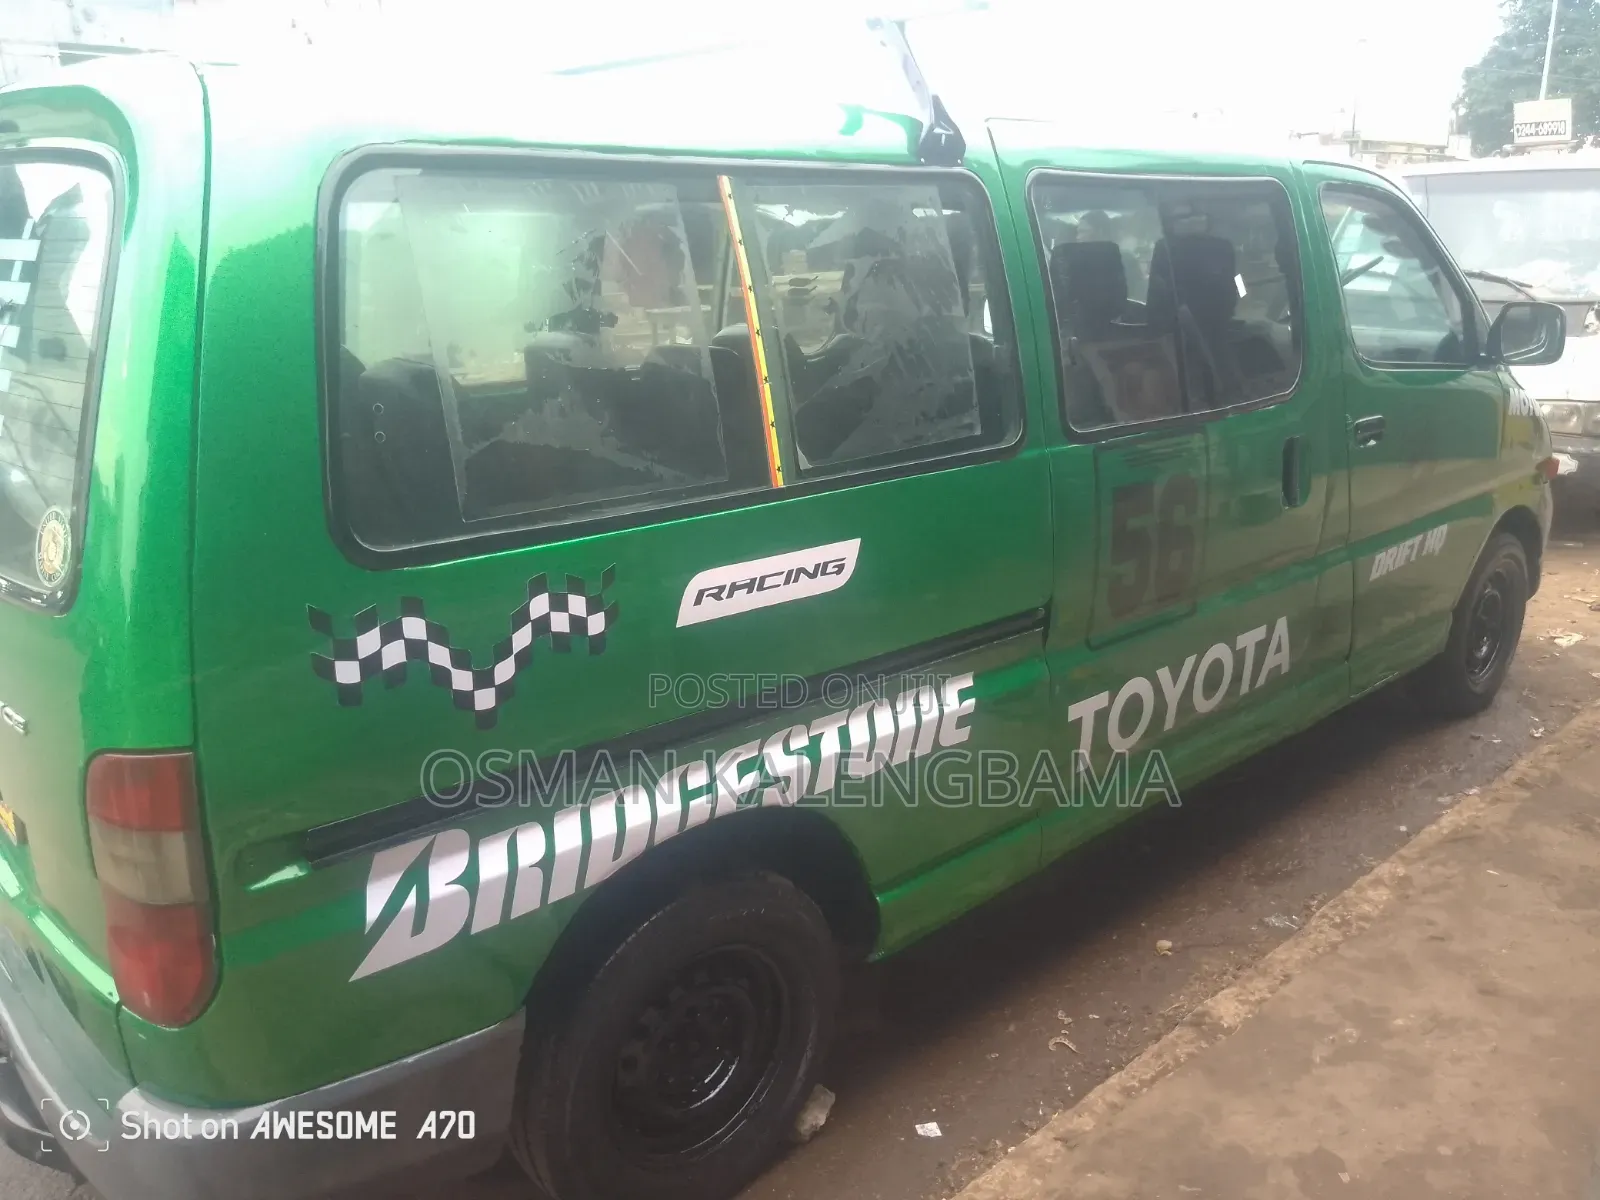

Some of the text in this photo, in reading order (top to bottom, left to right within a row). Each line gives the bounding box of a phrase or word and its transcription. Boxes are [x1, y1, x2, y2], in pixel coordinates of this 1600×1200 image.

[692, 557, 846, 607] RACING
[1106, 473, 1198, 618] 56
[1369, 534, 1423, 581] DRIFT
[1067, 616, 1291, 773] TOYOTA
[348, 671, 976, 983] BRIDGESTONE
